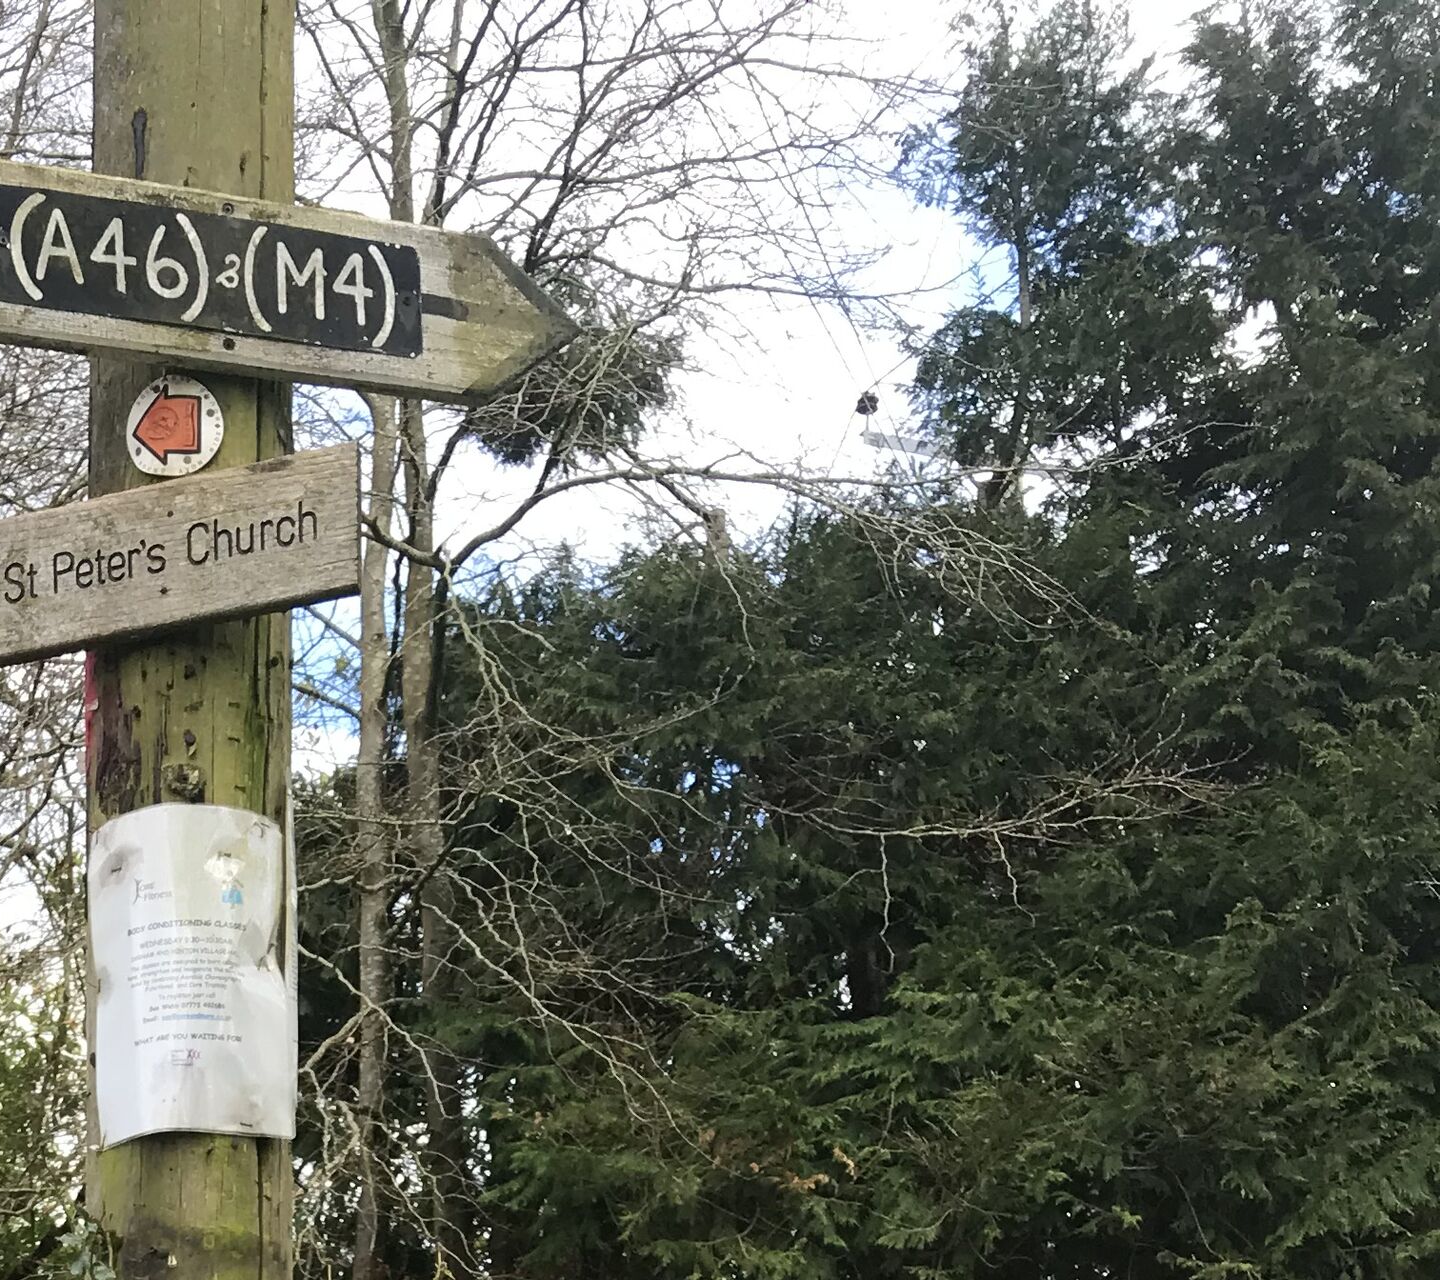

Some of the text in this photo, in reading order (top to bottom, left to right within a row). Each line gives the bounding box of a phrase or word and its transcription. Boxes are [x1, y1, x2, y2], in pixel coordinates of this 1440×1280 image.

[10, 192, 209, 322] (A46)
[244, 225, 396, 348] (M4)
[3, 500, 318, 604] St Peter's Church
[147, 919, 212, 931] CONDITIONING
[172, 1032, 188, 1041] YOU
[191, 1032, 226, 1042] WAITING
